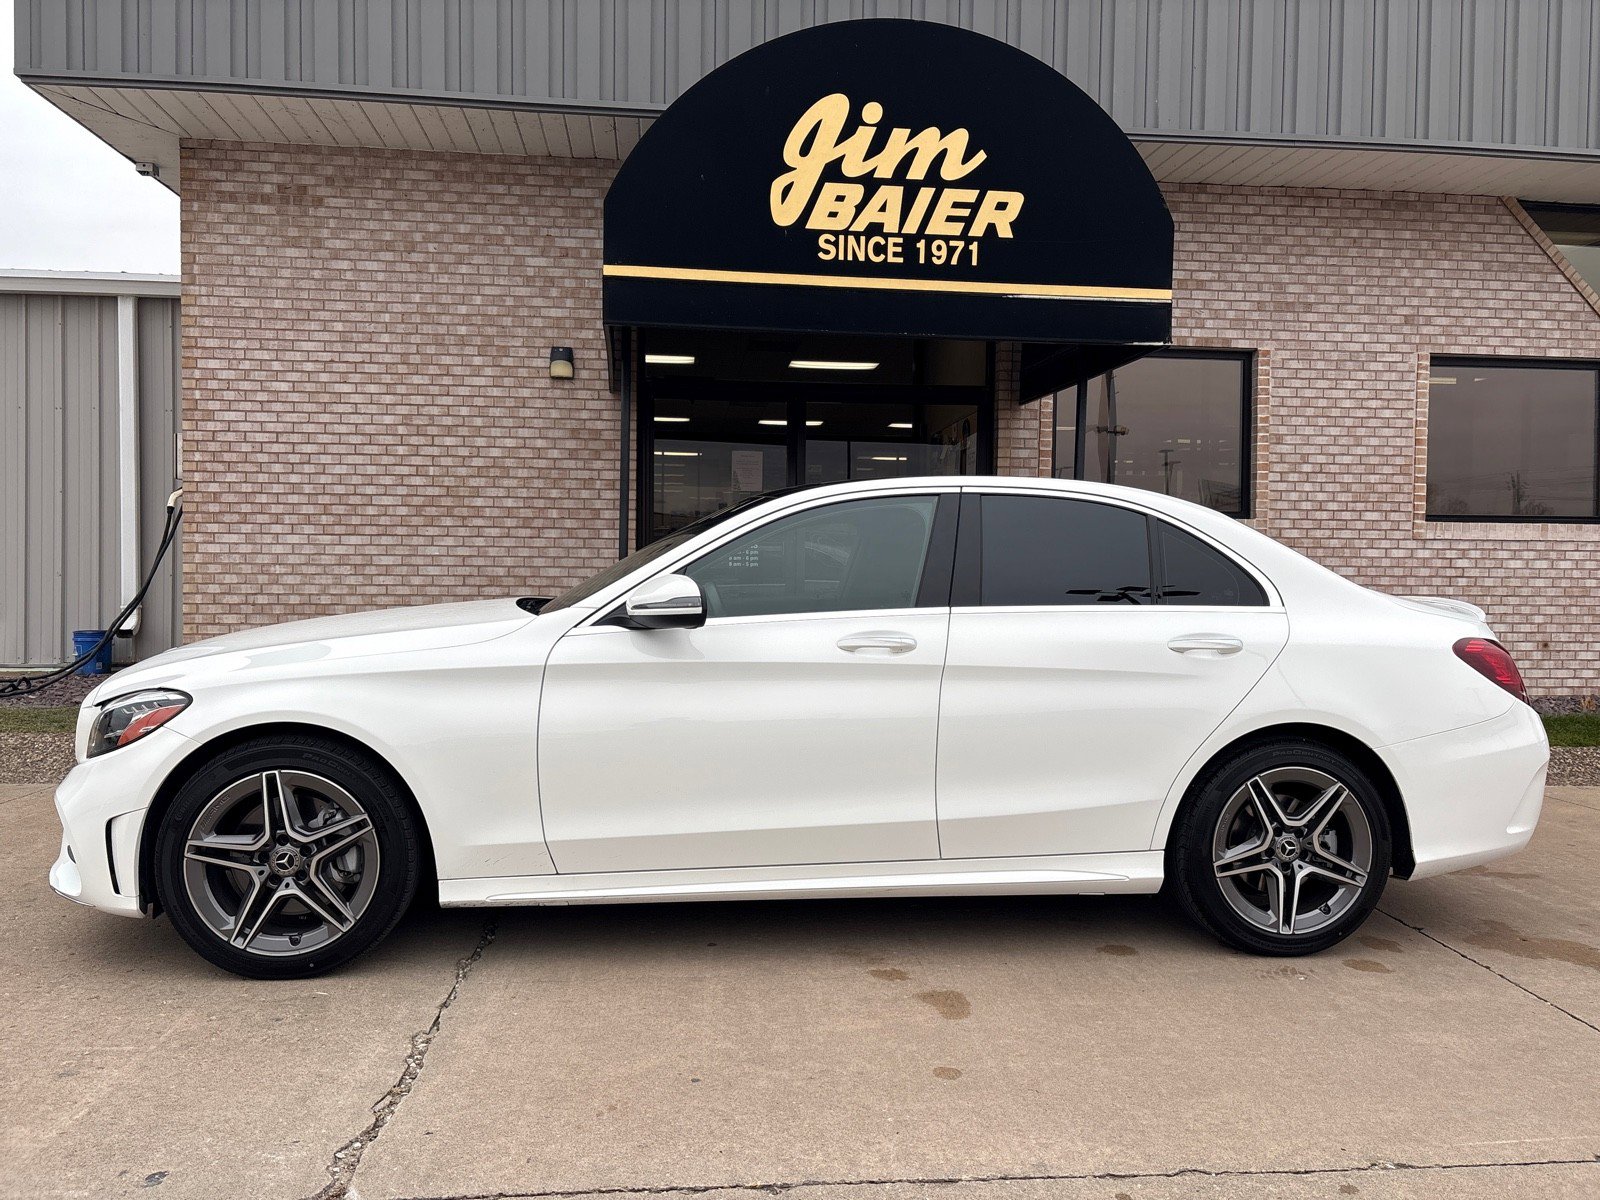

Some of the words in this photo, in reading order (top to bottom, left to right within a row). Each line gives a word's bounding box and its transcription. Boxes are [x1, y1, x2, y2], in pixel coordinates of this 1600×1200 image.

[770, 93, 987, 227] Jim
[805, 182, 1025, 239] BAIER
[817, 234, 904, 263] SINCE
[916, 239, 979, 266] 1971
